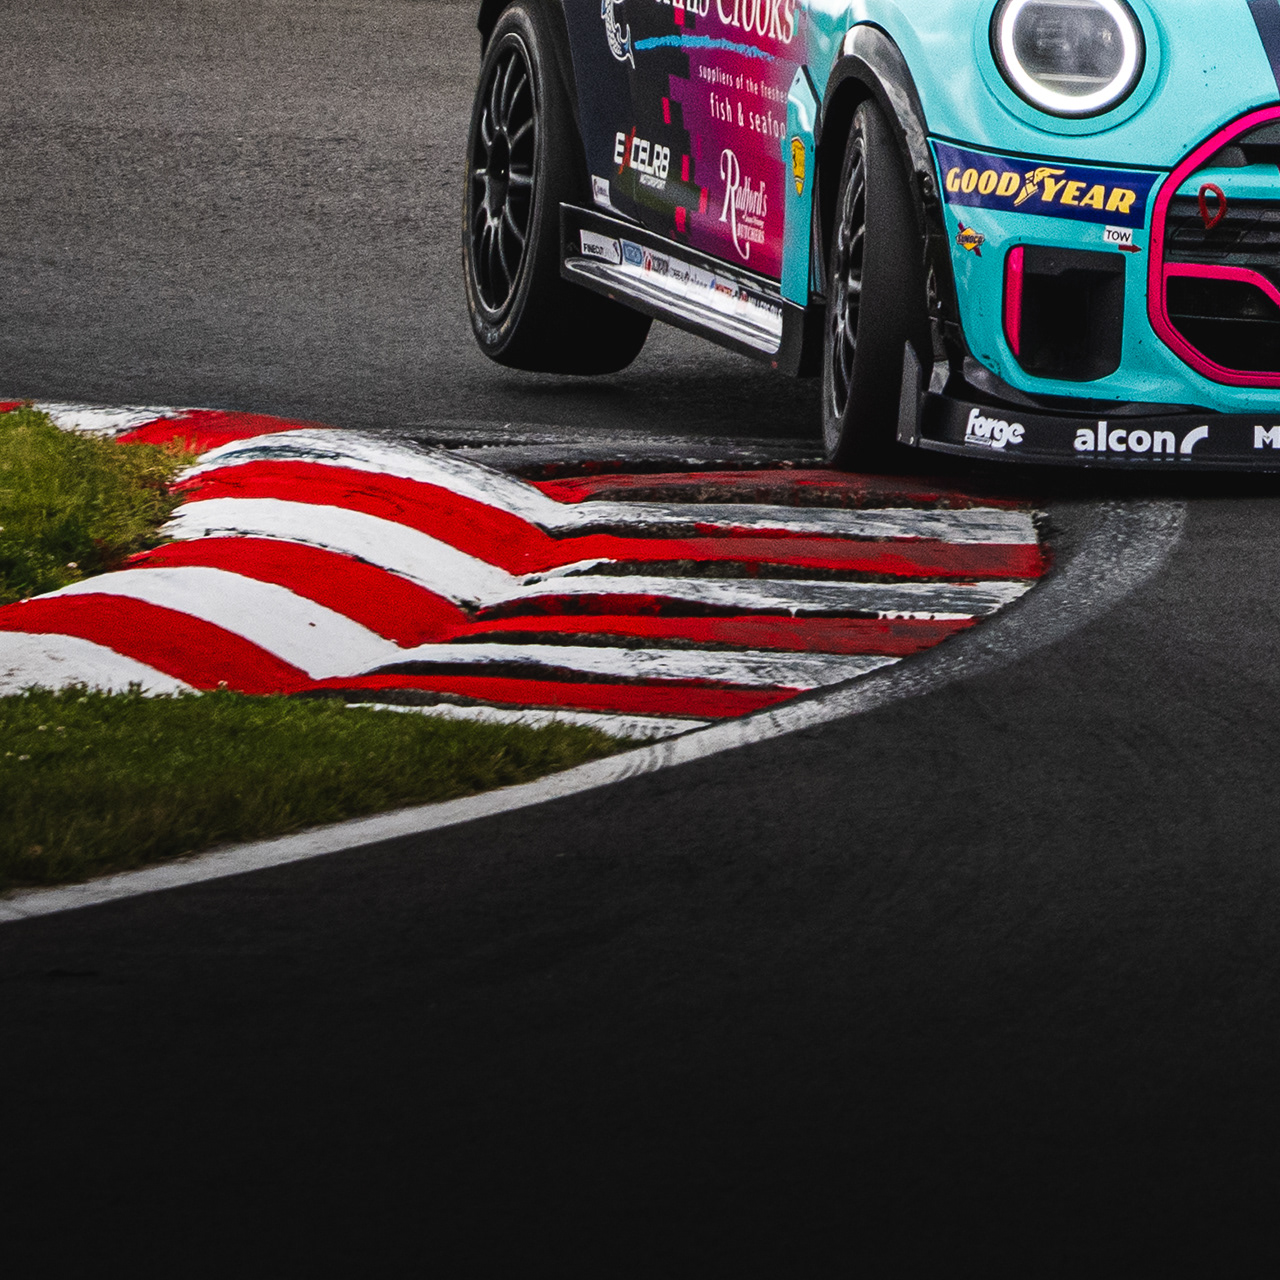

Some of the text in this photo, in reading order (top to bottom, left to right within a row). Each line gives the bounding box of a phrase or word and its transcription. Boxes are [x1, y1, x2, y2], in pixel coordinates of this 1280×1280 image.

[699, 65, 733, 87] suppliers
[736, 73, 744, 89] of
[746, 77, 758, 95] the
[710, 92, 732, 122] fish
[737, 102, 744, 127] &
[614, 126, 671, 180] EXCELR8
[1106, 228, 1132, 243] TOW
[966, 408, 1026, 449] forge
